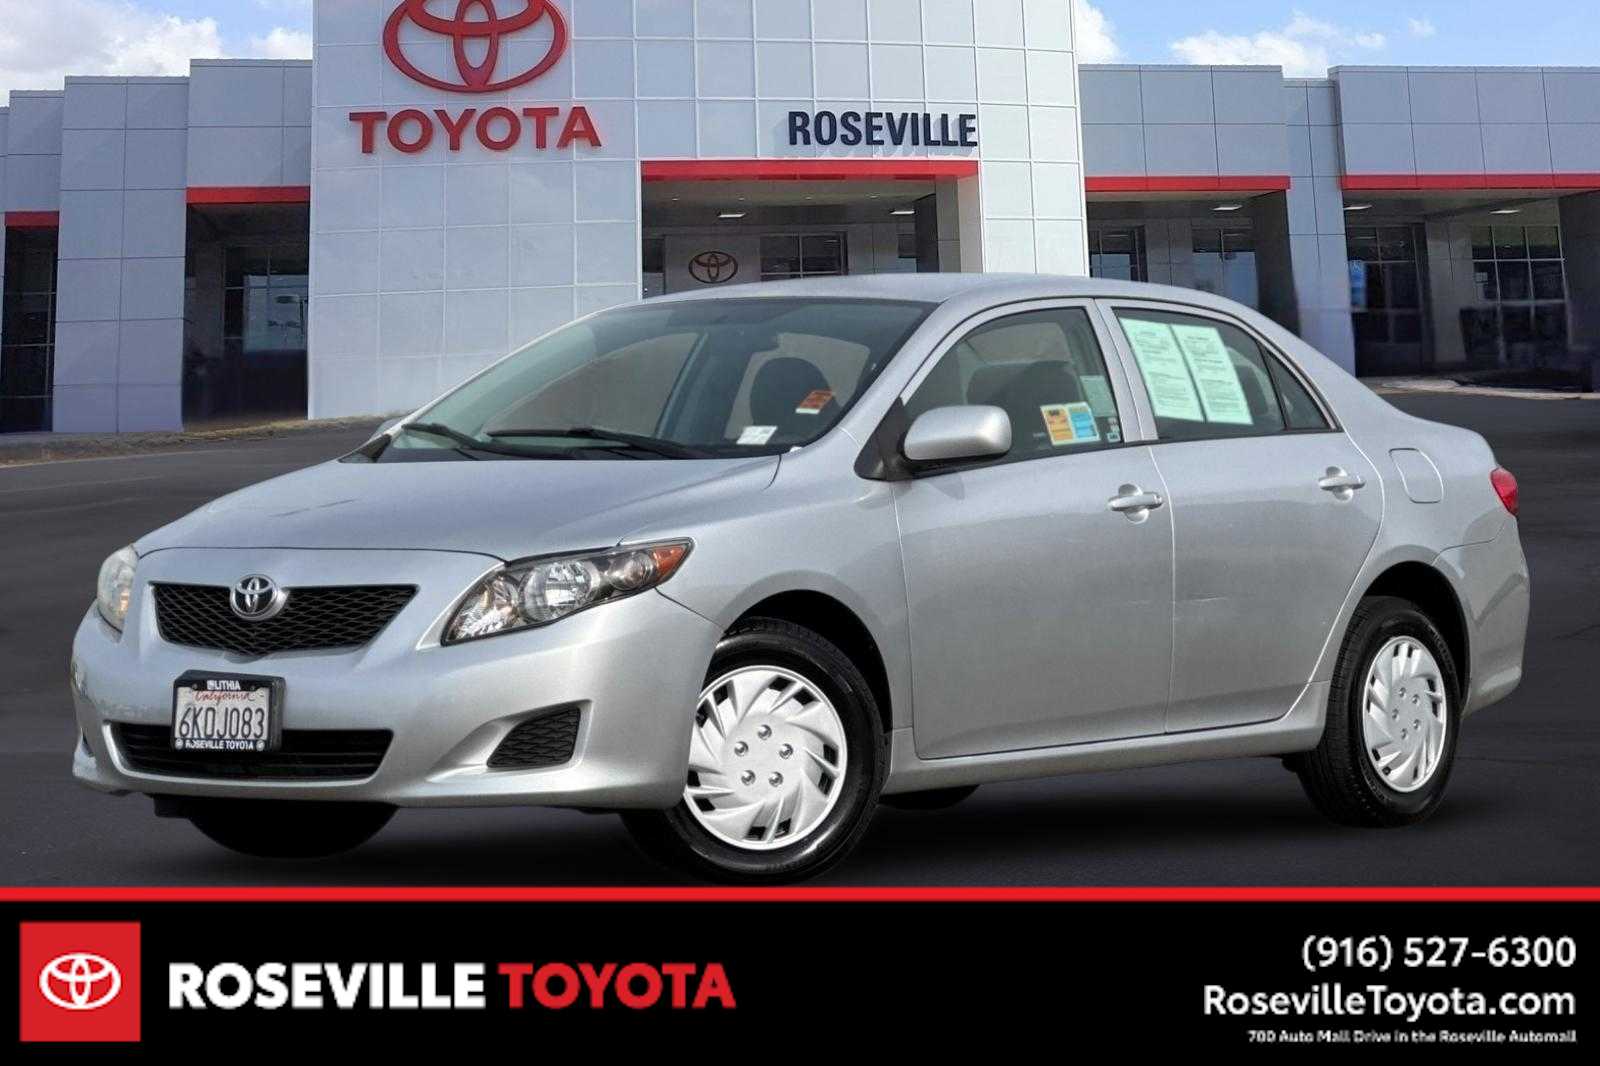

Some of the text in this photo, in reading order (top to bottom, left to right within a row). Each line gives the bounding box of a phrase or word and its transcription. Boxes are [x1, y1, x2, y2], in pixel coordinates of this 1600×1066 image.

[349, 106, 602, 153] TOYOTA
[788, 111, 978, 147] ROSEVILLE
[214, 680, 241, 690] LITHIA
[194, 690, 251, 705] California
[185, 739, 254, 750] ROSEVILLE TOYOTA
